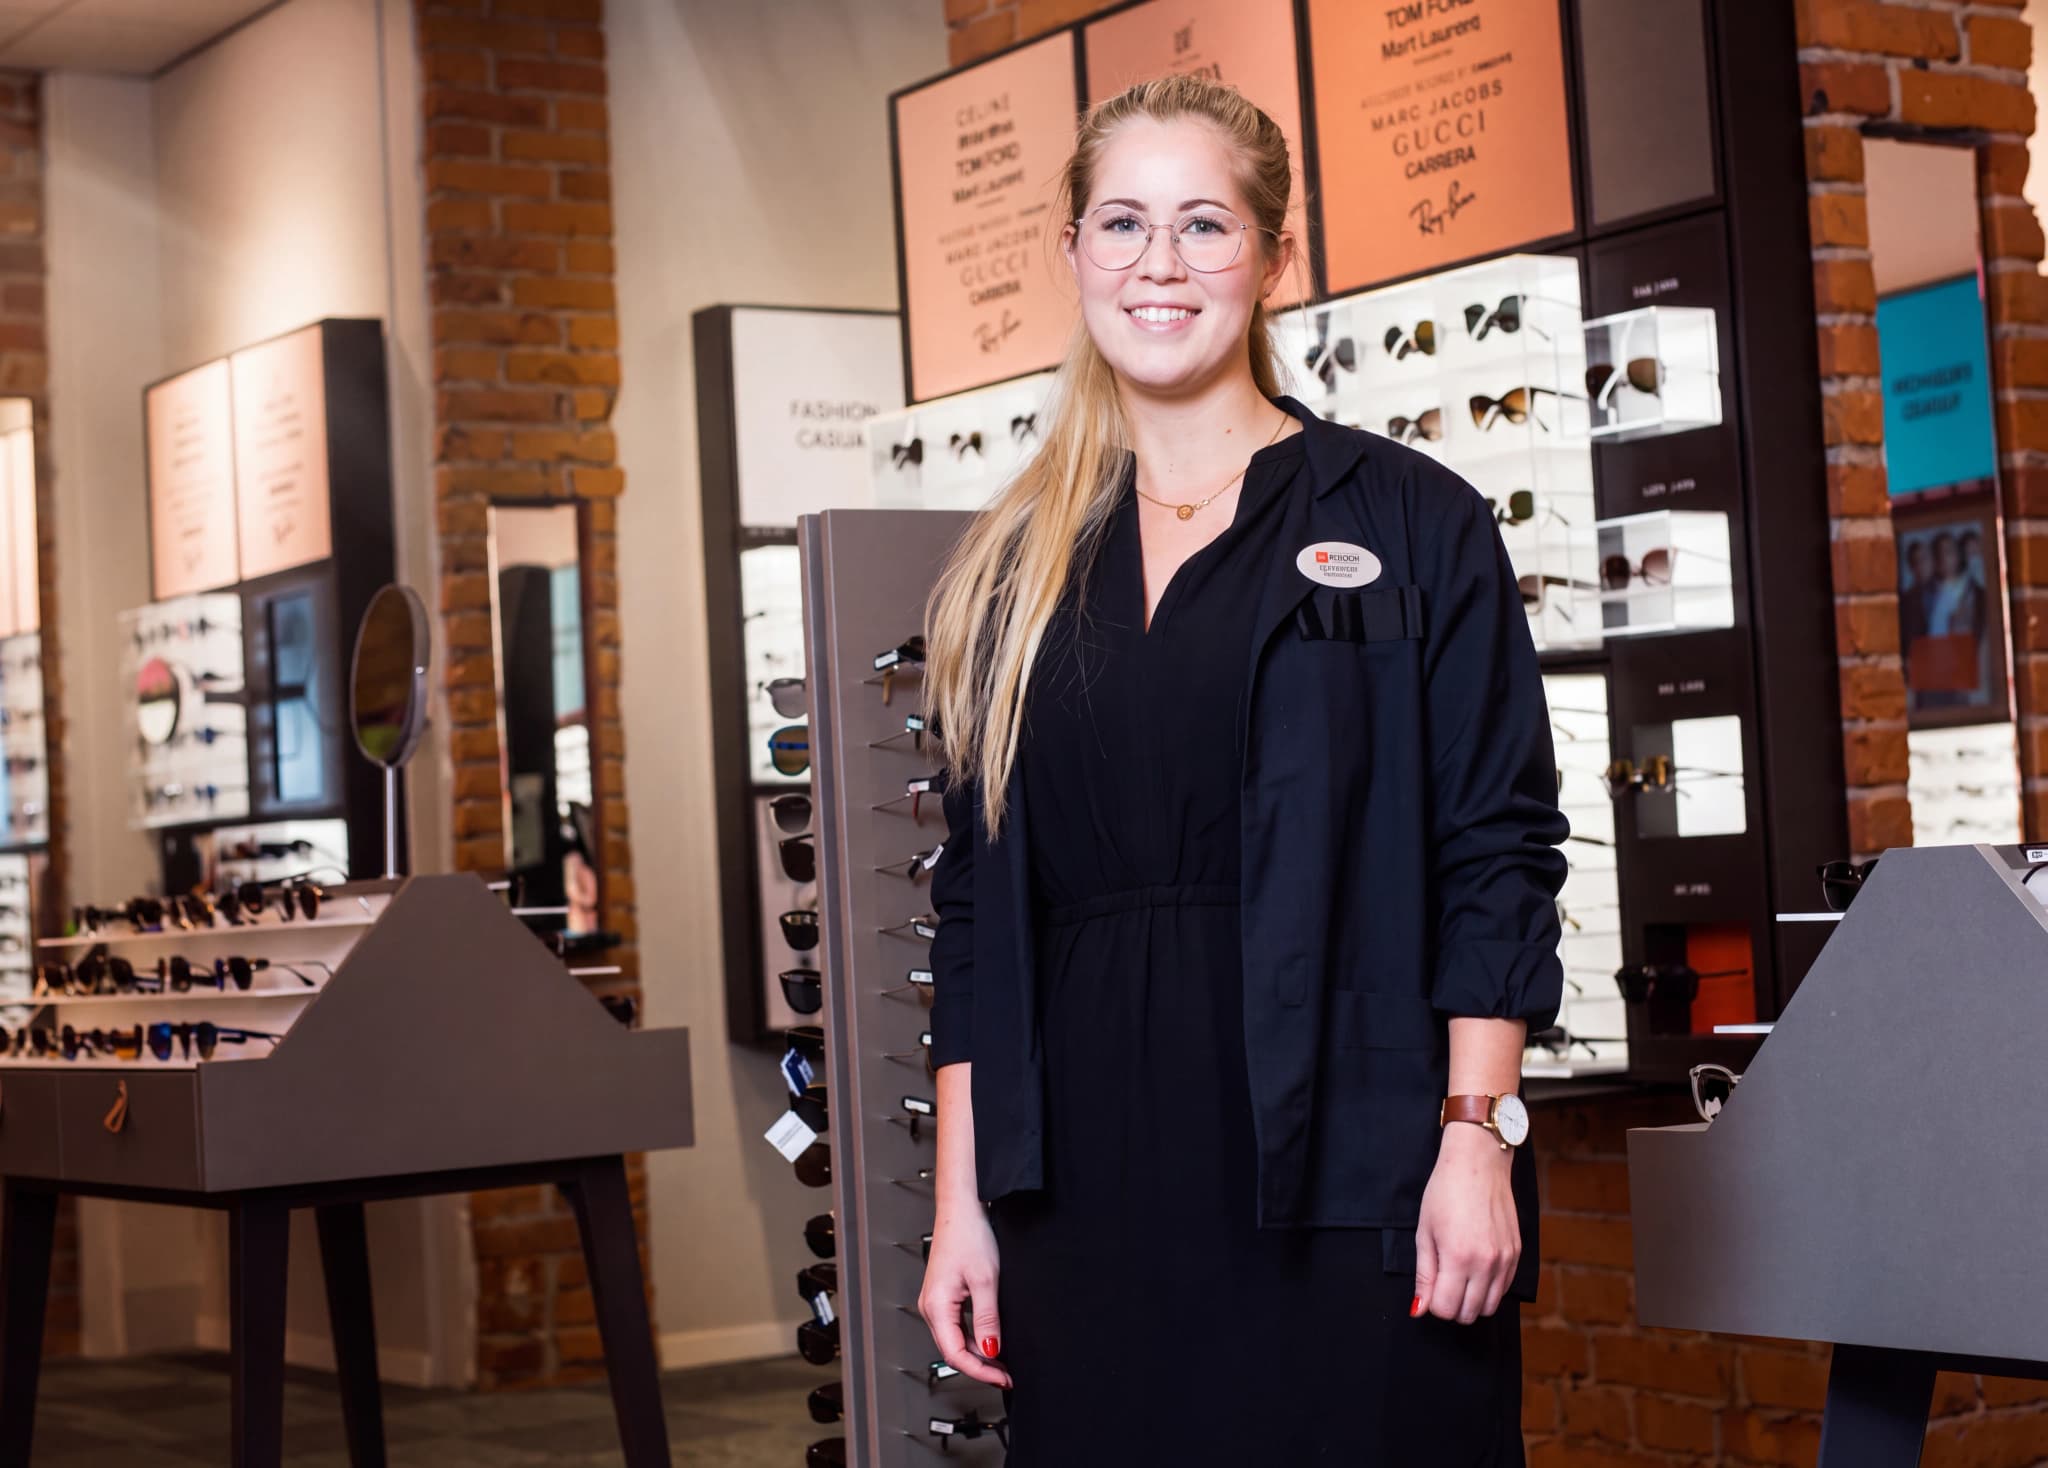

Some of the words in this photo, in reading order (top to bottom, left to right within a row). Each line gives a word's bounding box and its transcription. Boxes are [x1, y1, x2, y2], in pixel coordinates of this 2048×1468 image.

[1384, 0, 1423, 30] TOM
[1371, 105, 1420, 131] MARC
[1429, 79, 1503, 116] JACOBS
[1392, 108, 1485, 157] GUCCI
[1404, 145, 1476, 179] CARRERA
